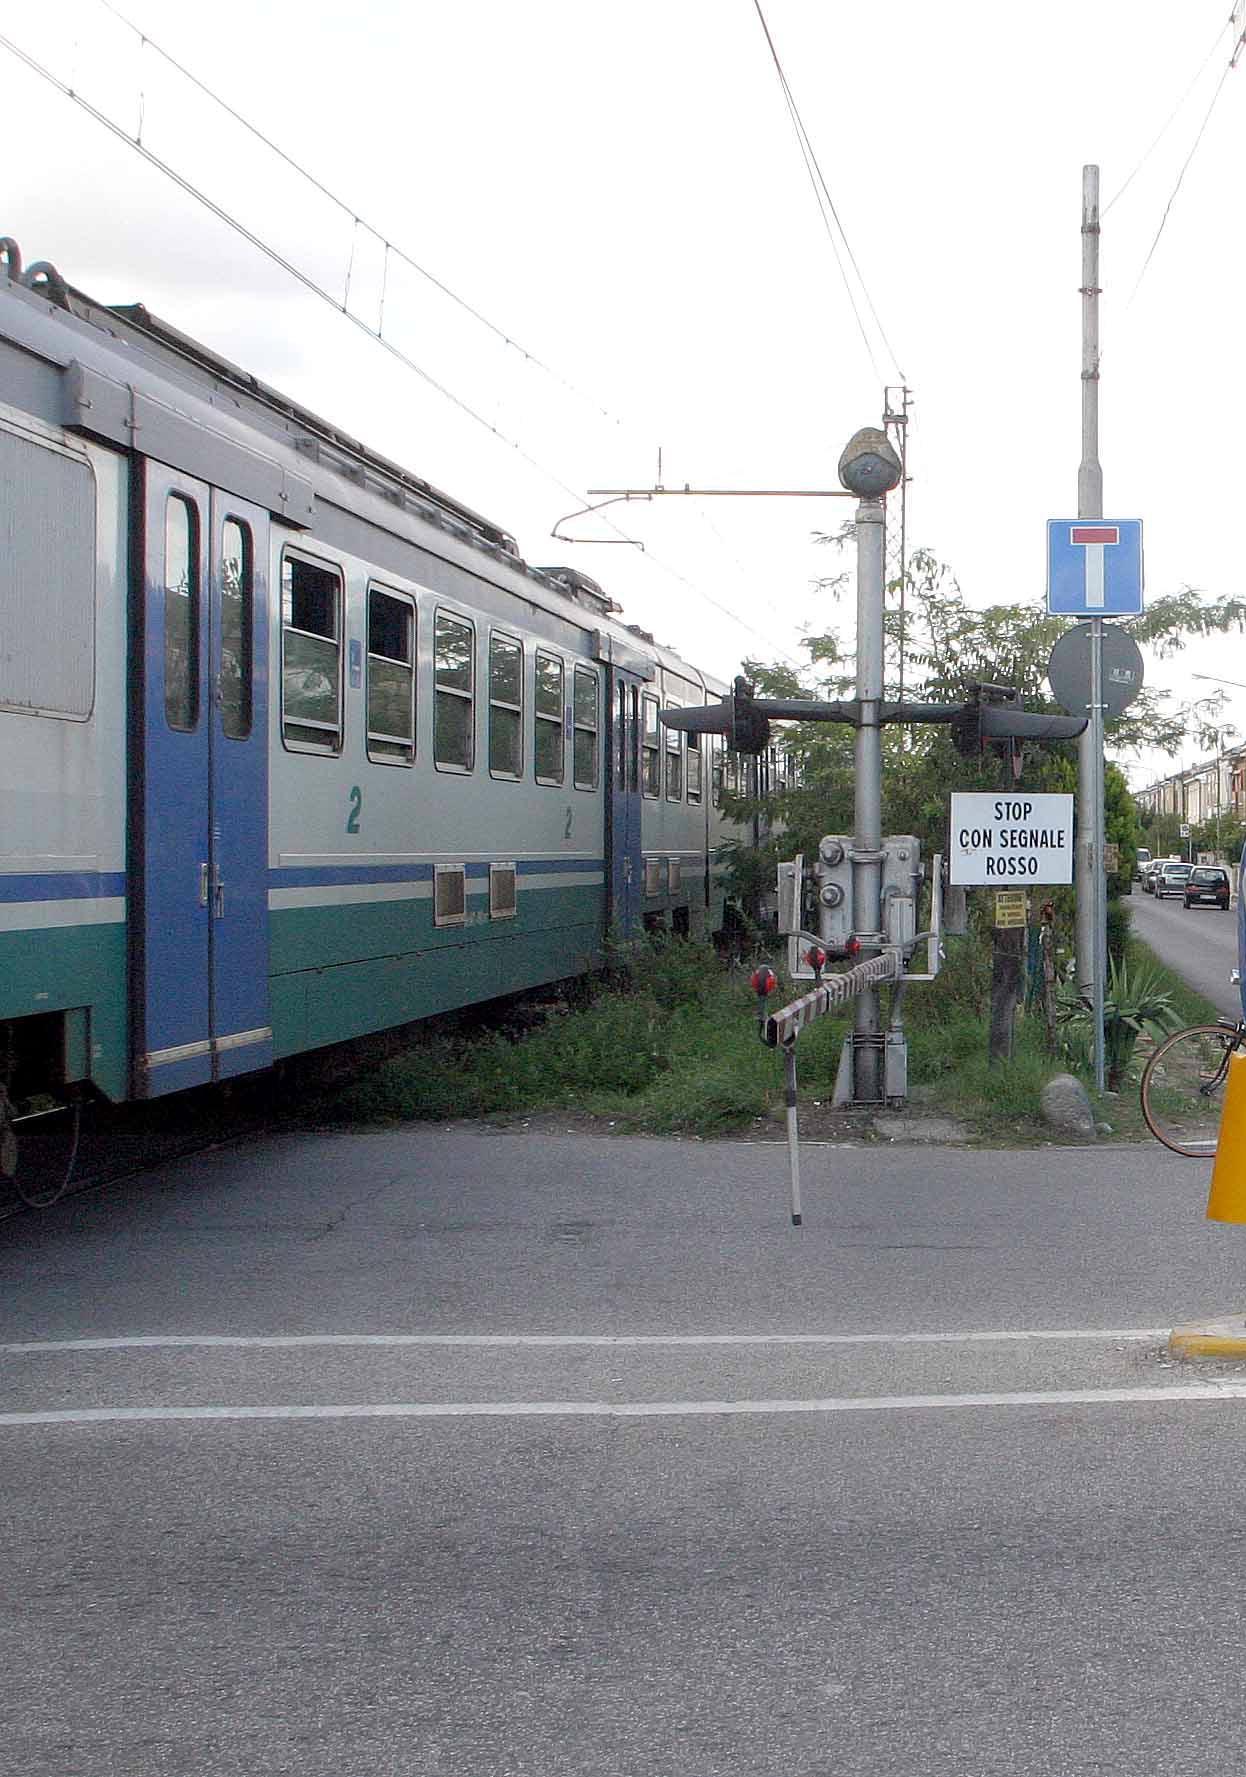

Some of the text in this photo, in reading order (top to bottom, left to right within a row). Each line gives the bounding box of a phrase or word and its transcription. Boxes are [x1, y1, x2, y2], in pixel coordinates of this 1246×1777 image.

[346, 785, 363, 834] 2
[994, 802, 1032, 821] STOP
[564, 806, 573, 840] 2
[959, 829, 1065, 848] CON SEGNALE
[986, 856, 1038, 876] ROSSO
